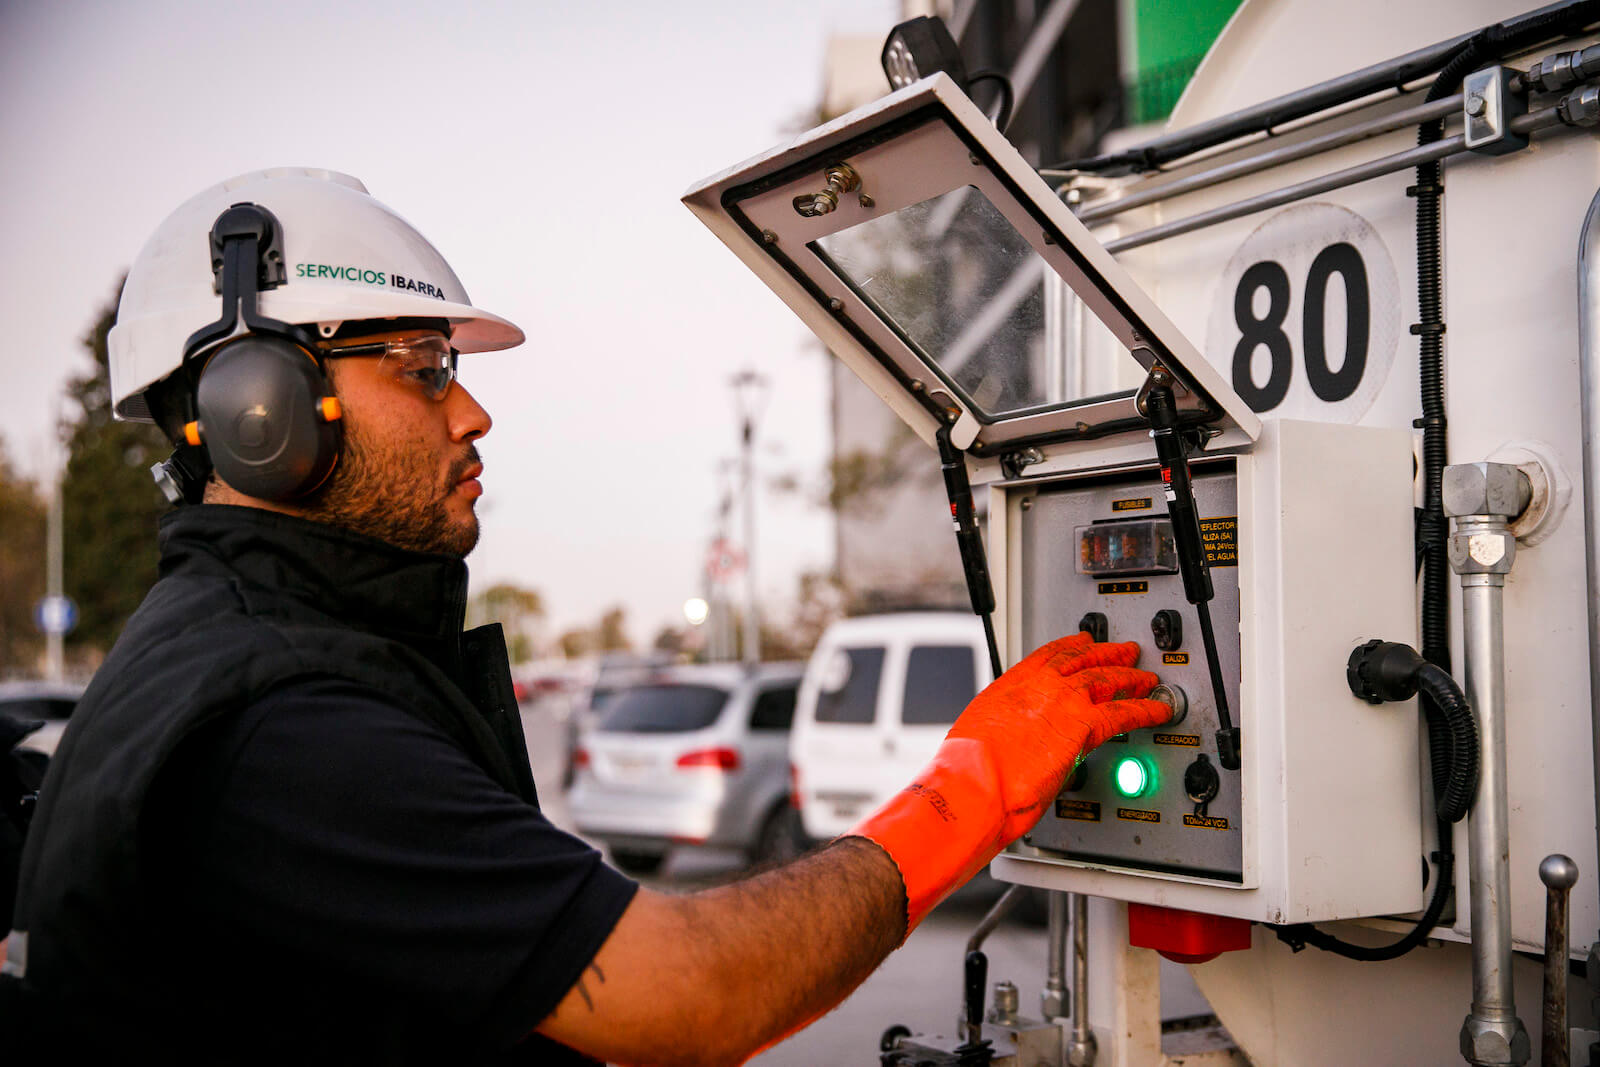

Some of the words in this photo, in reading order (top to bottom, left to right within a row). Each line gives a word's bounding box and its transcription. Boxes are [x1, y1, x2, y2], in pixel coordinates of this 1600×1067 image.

[296, 263, 386, 285] SERVICIOS
[391, 274, 446, 300] IBARRA
[1232, 242, 1370, 413] 80
[1200, 521, 1235, 532] EFLECTOR
[1202, 532, 1219, 541] ALIZA
[1206, 553, 1216, 561] EL
[1217, 552, 1235, 561] AGUA
[1165, 654, 1186, 663] BALIZA
[1120, 809, 1158, 821] ENERGIZADO
